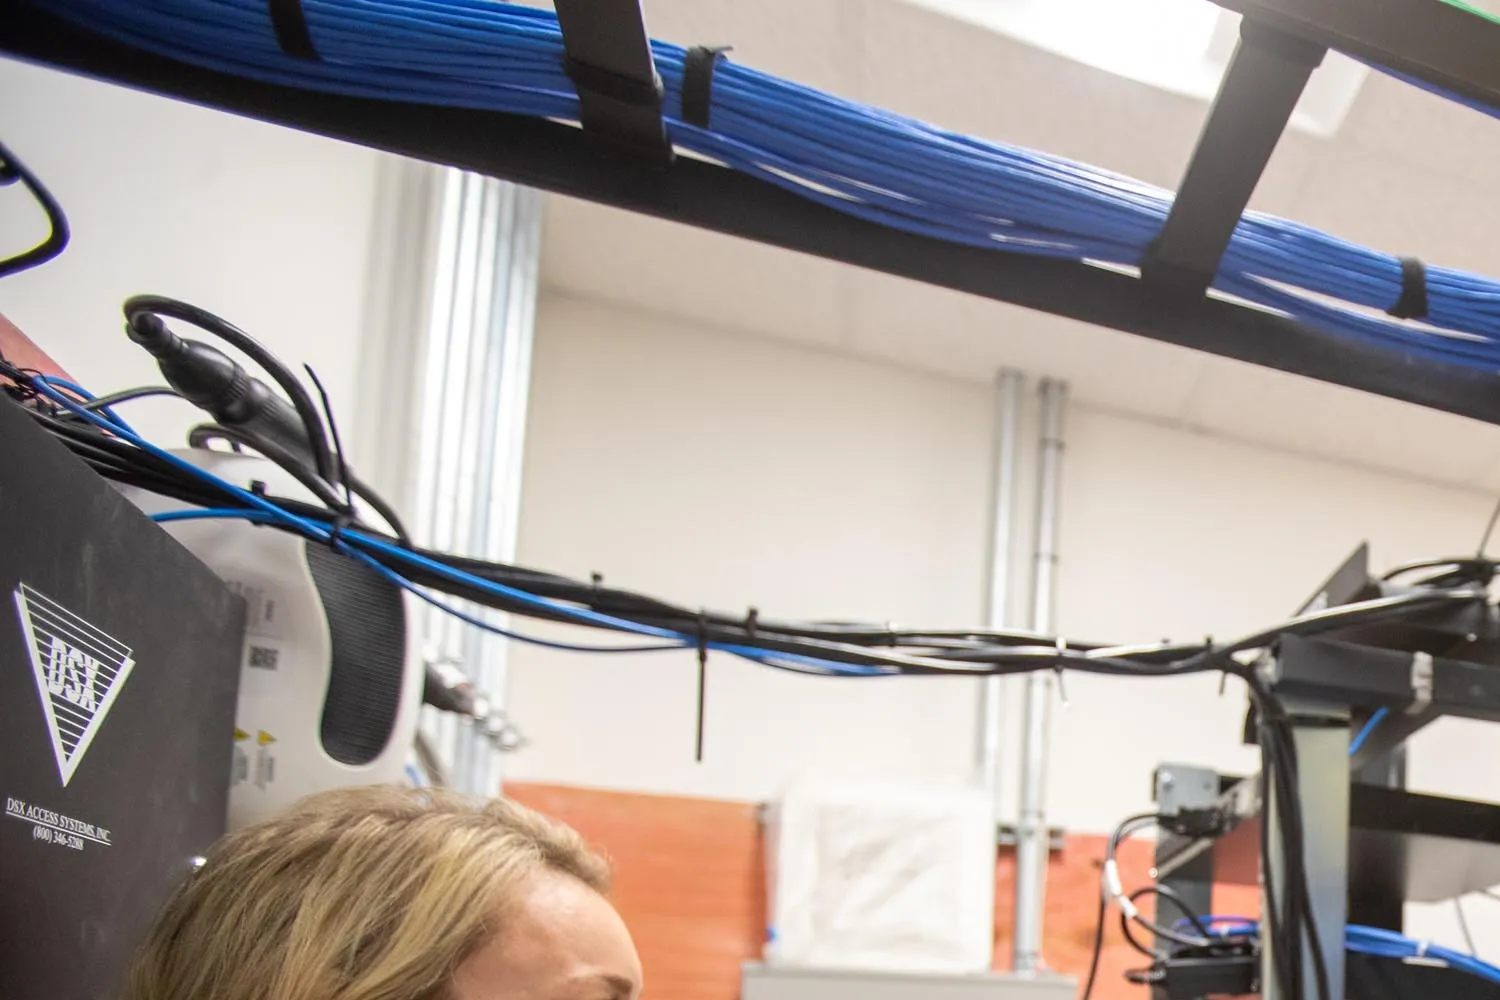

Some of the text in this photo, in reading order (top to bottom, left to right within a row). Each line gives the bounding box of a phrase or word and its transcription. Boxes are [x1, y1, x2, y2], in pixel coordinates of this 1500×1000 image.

[48, 636, 99, 712] DSX
[7, 797, 26, 815] DSX
[26, 804, 59, 826] ACCESS
[33, 825, 53, 844] (800)
